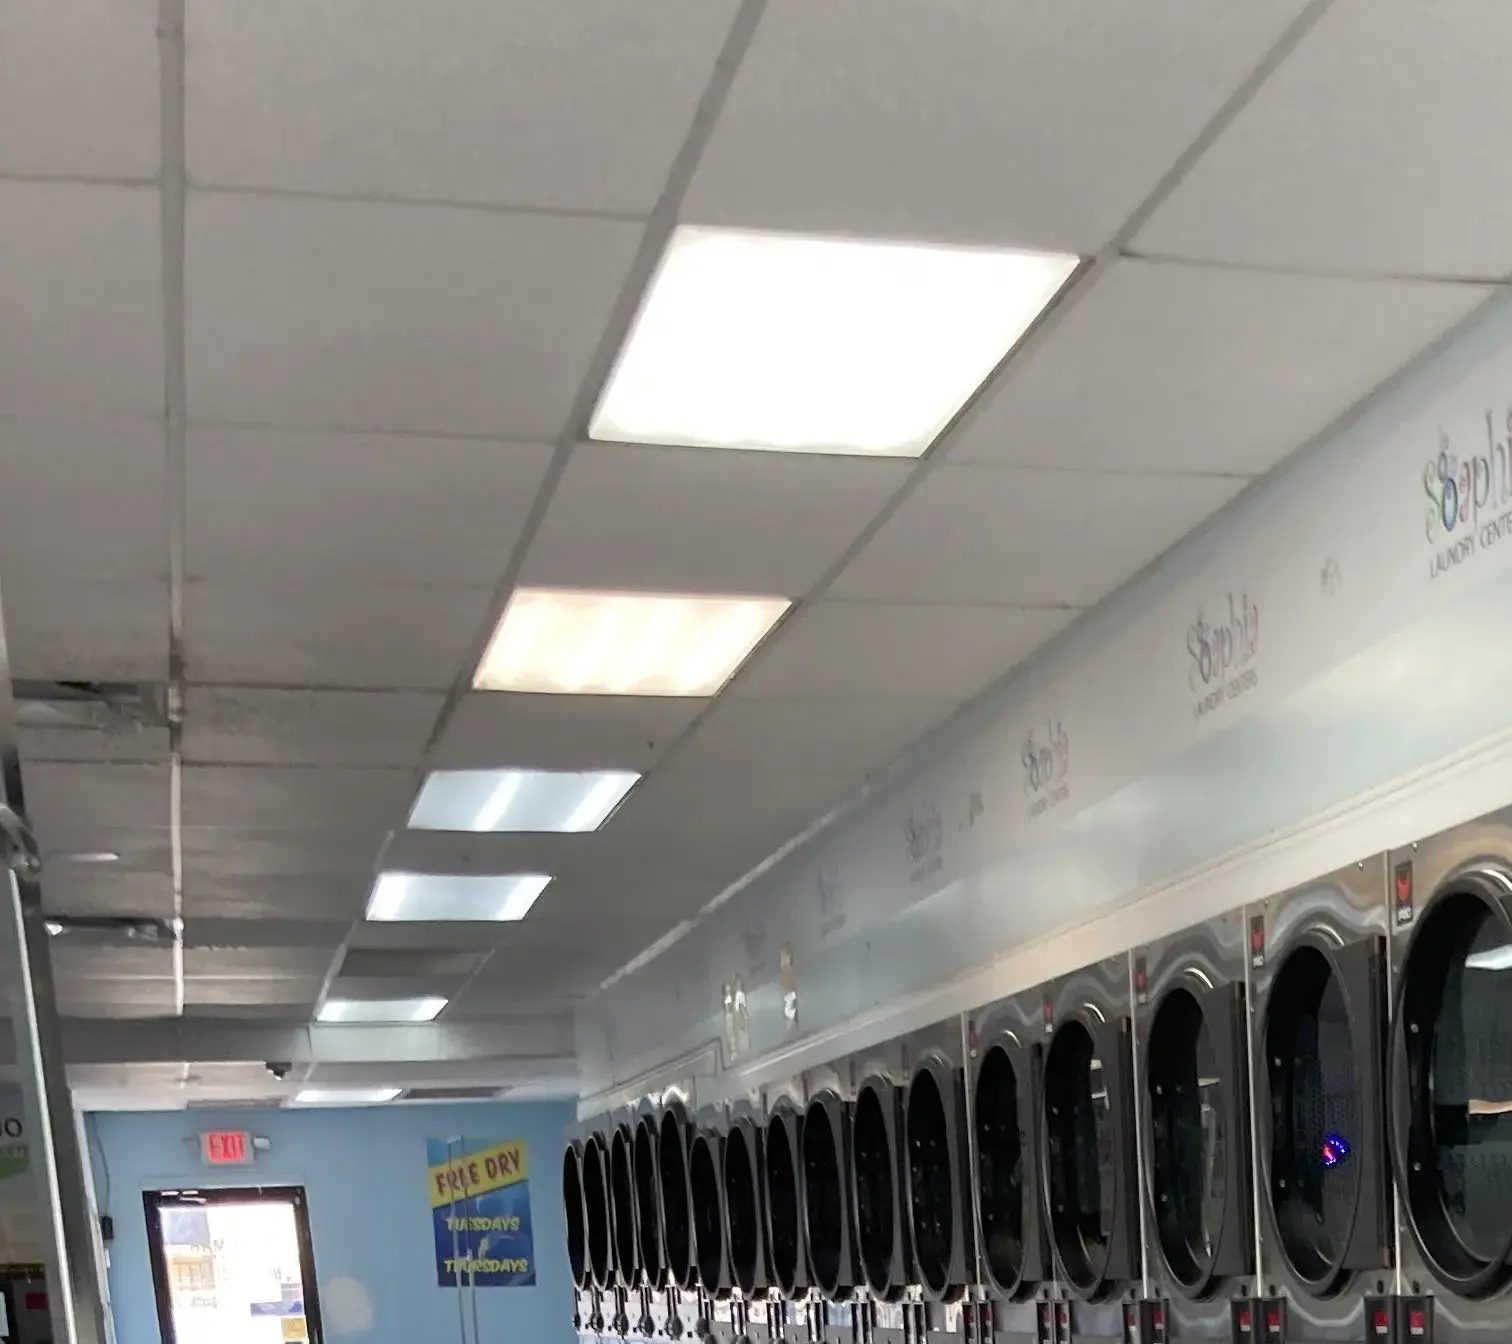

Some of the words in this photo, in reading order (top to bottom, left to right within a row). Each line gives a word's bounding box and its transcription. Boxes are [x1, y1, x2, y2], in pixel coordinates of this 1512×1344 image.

[209, 1134, 244, 1159] EXIT
[435, 1161, 480, 1197] FREE
[484, 1147, 521, 1180] DRY
[446, 1216, 520, 1231] TUESDAYS
